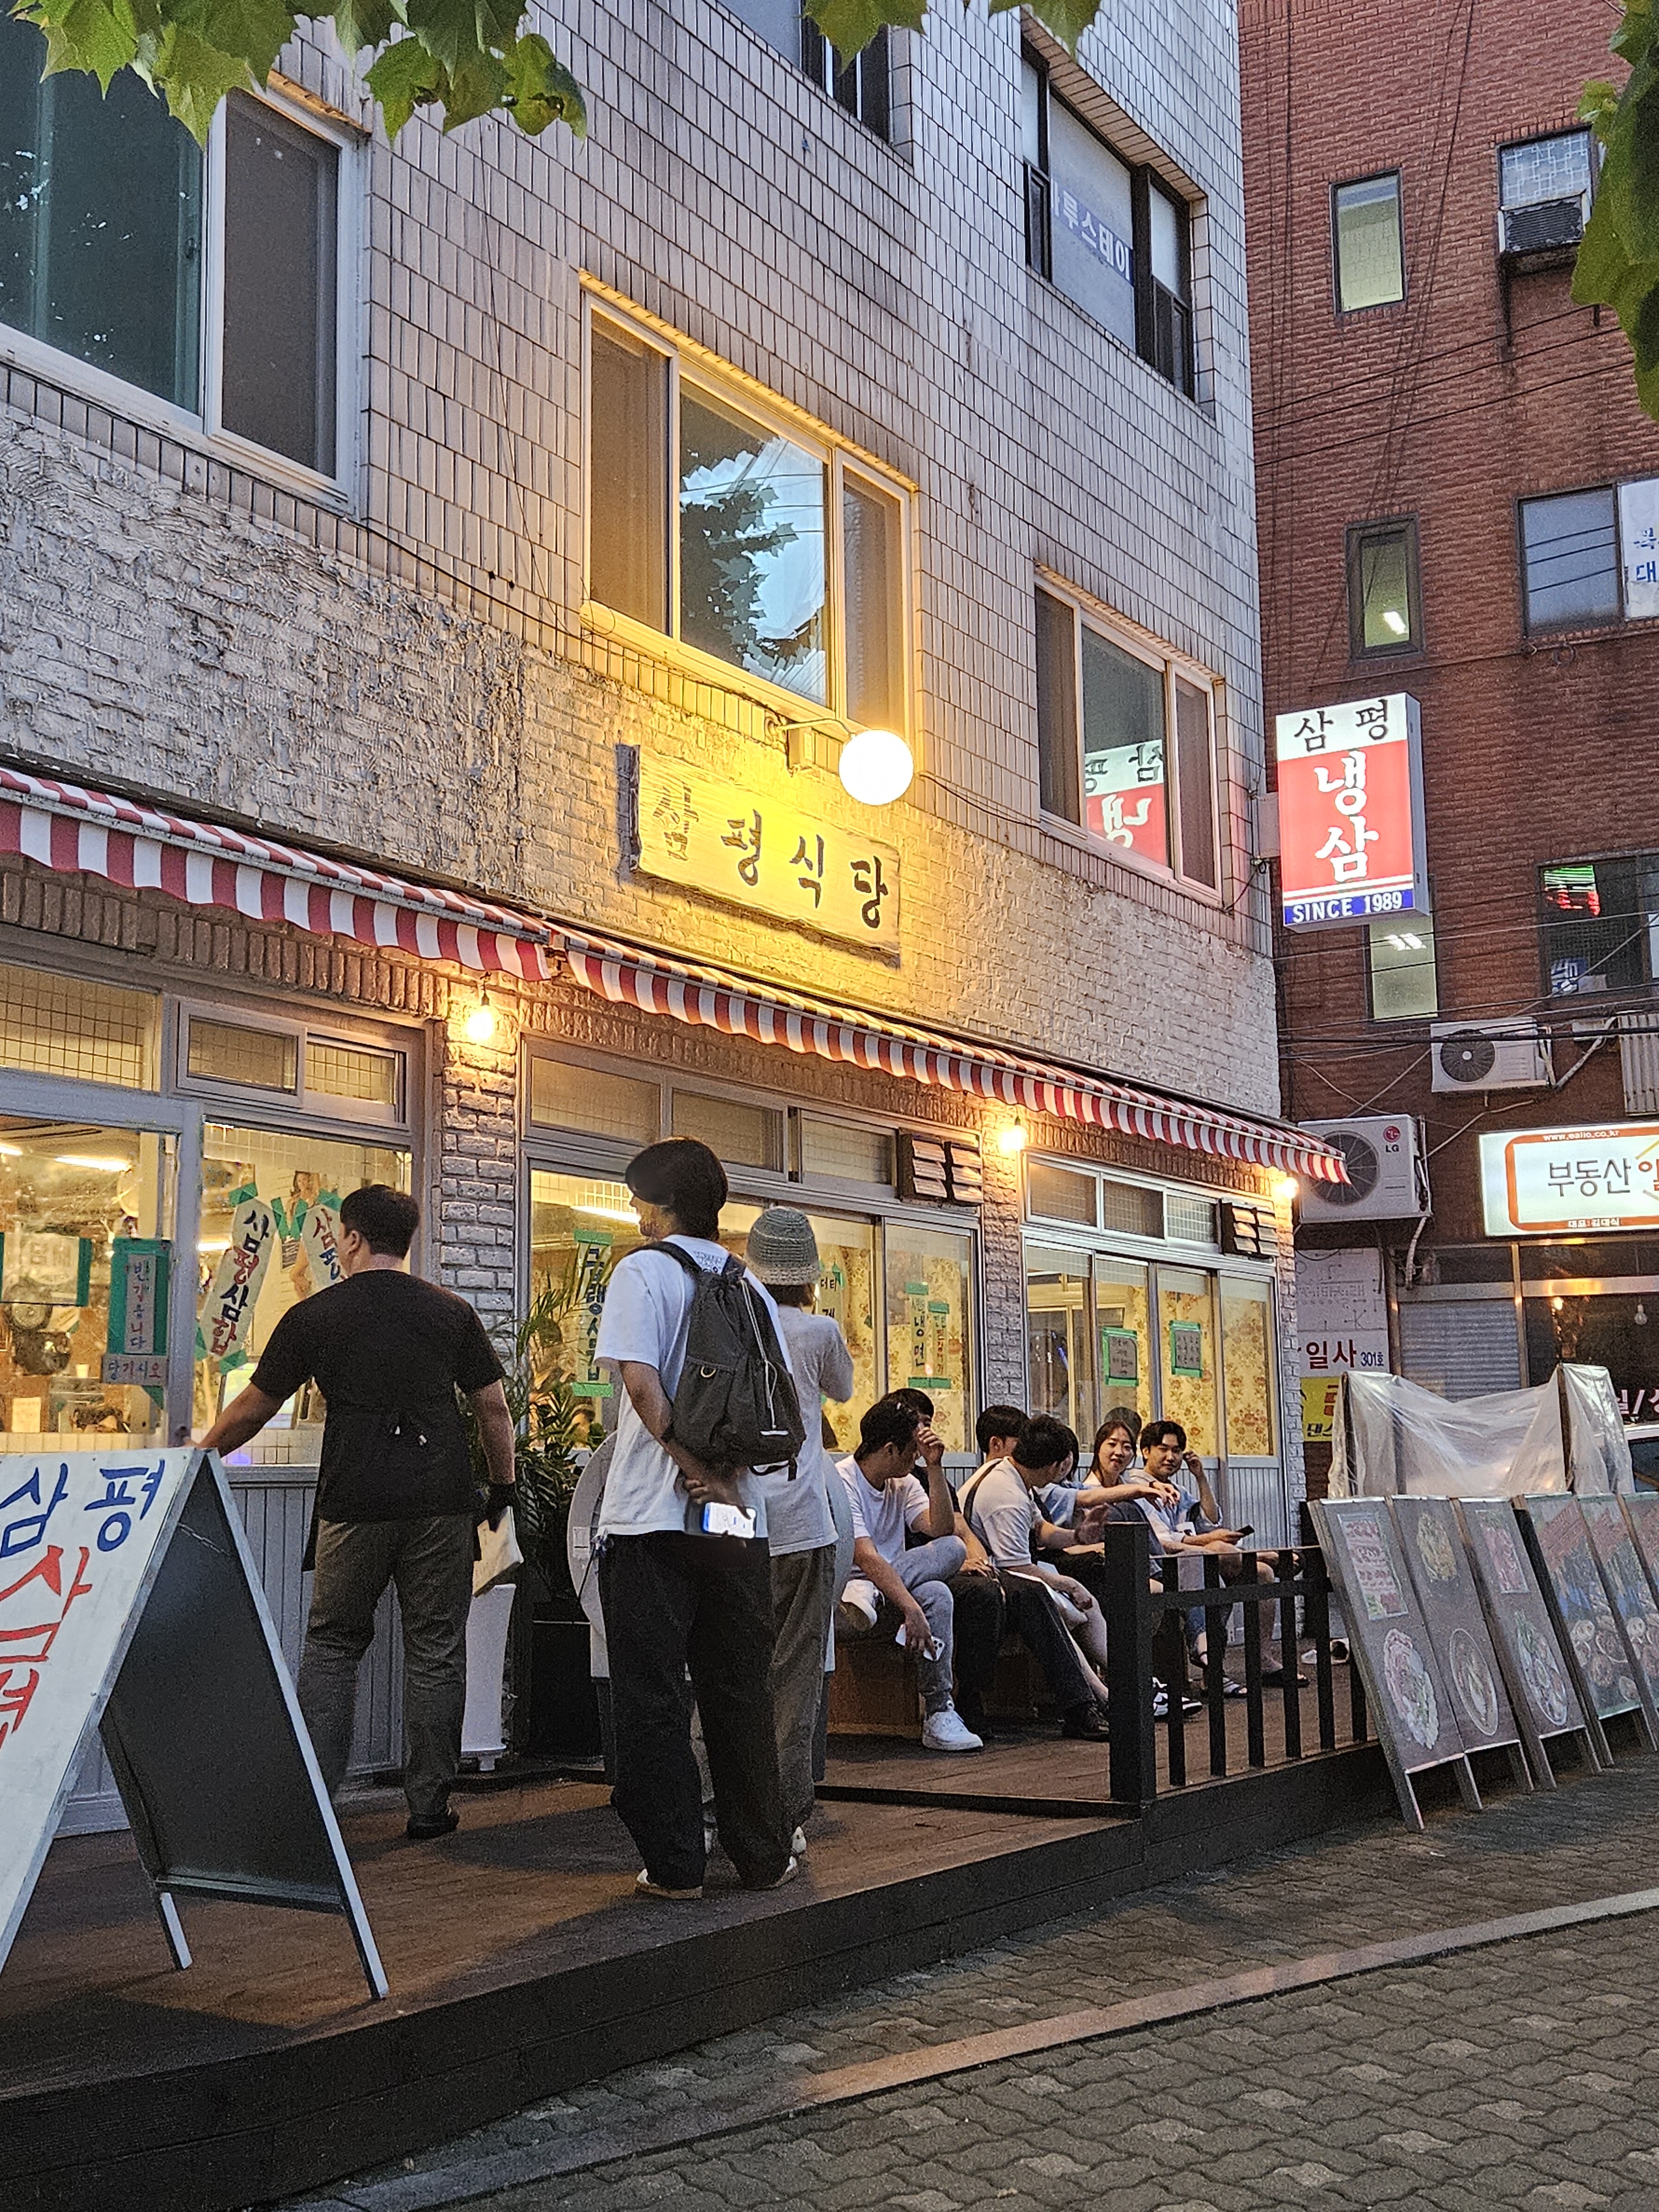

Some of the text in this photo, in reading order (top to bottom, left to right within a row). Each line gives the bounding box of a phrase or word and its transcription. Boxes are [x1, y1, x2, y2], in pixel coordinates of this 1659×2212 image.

[1294, 698, 1389, 752] 삼평
[1314, 750, 1379, 883] 냉삼
[1292, 891, 1403, 924] SINCE 1989
[1386, 1144, 1400, 1152] LG
[1548, 1158, 1631, 1197] 부동산
[312, 1208, 348, 1281] 삼평
[1297, 1339, 1385, 1369] 일사 301호
[0, 1459, 165, 1558] 삼평
